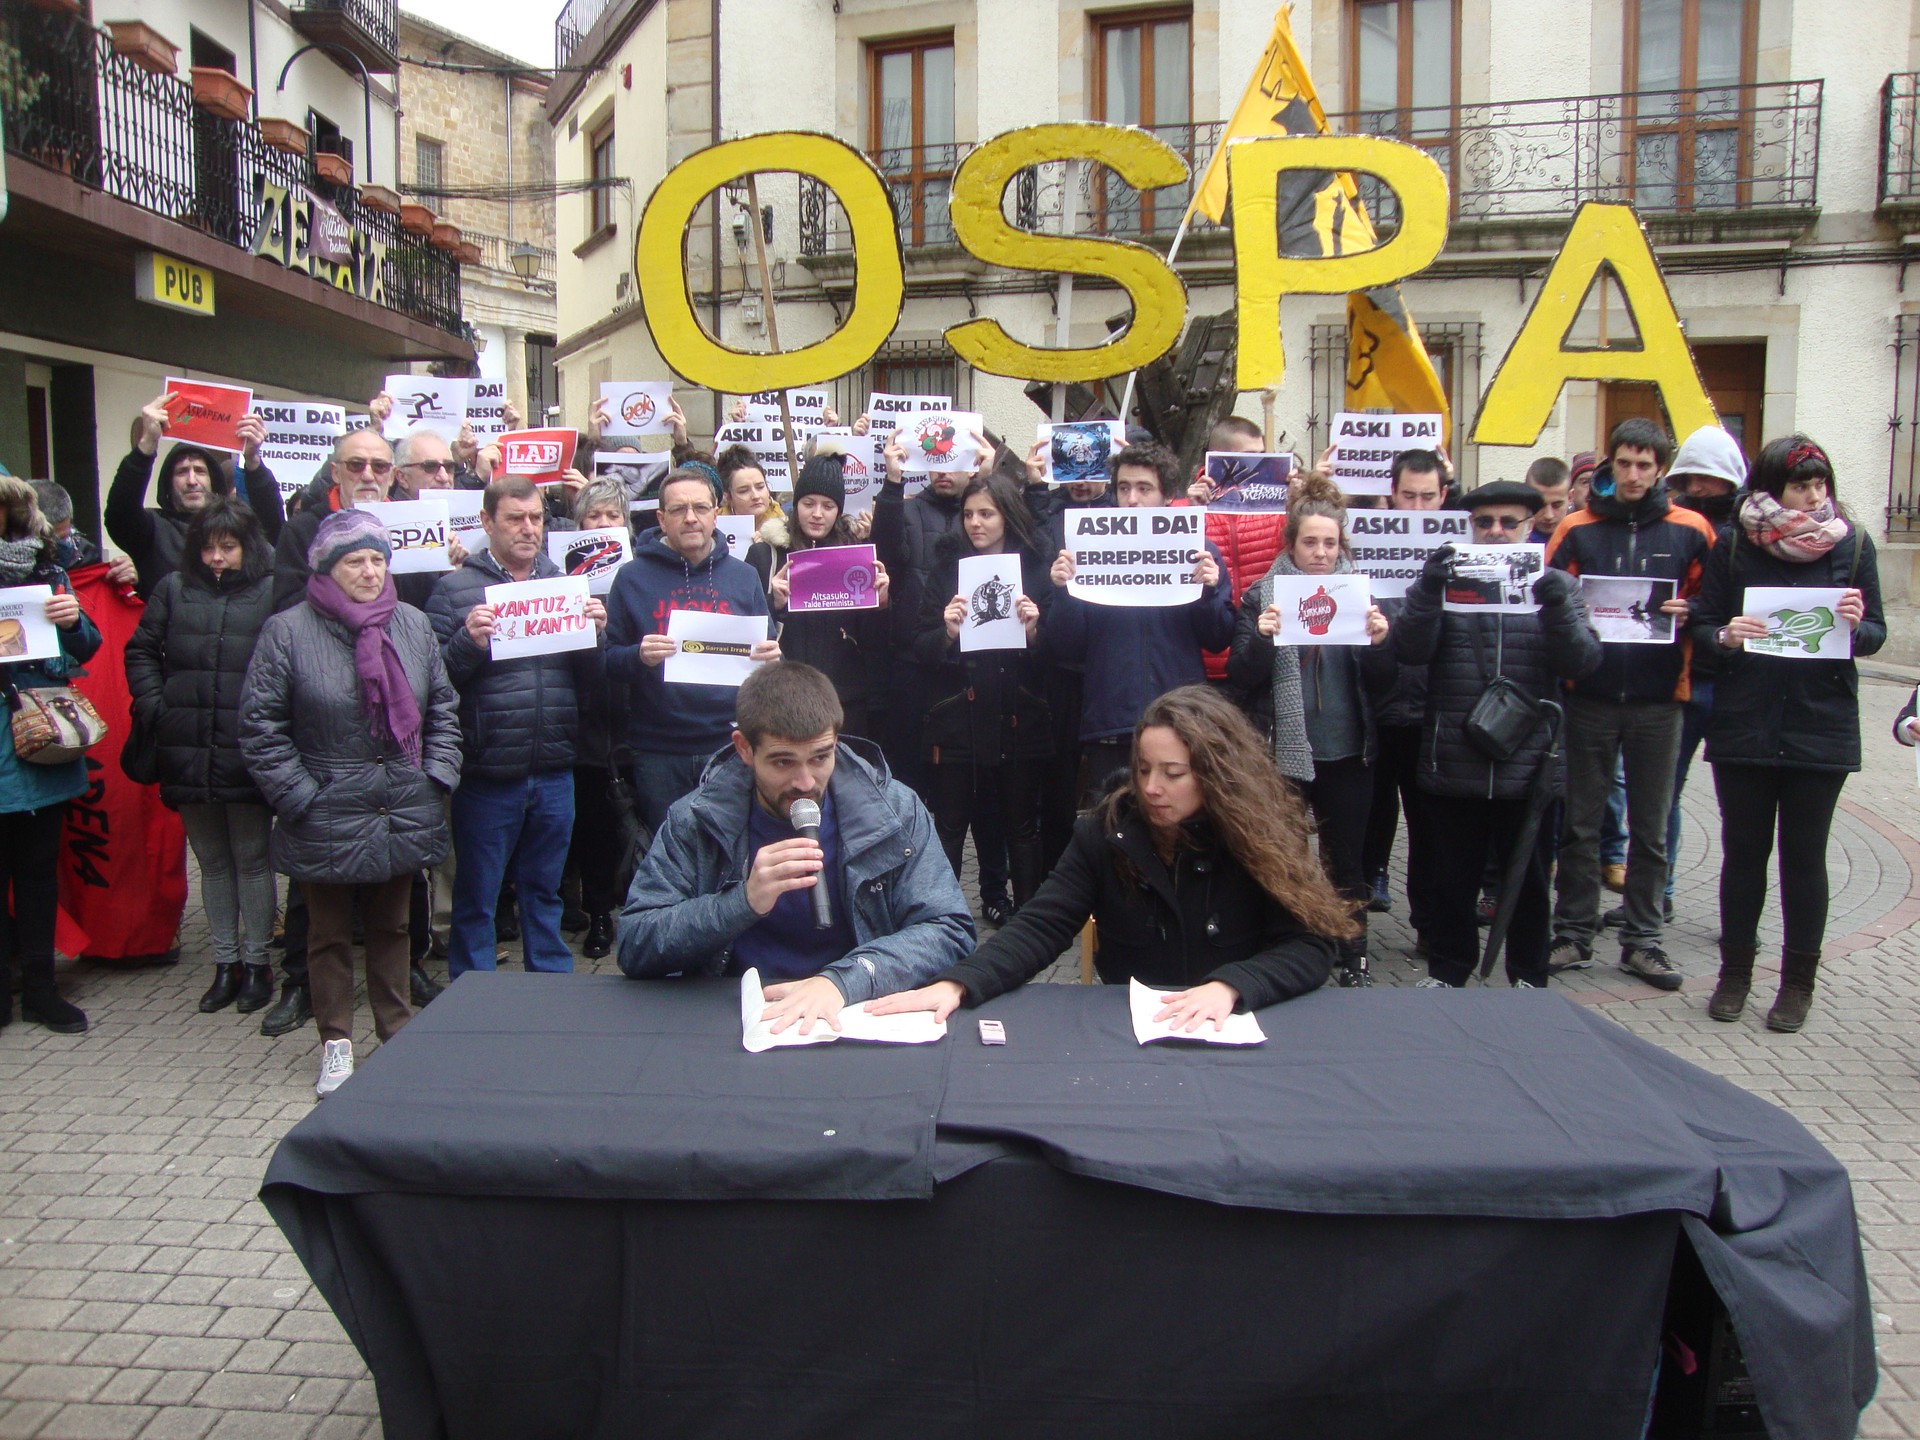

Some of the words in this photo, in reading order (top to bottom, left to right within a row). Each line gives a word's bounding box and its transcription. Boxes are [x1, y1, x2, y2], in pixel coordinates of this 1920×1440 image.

[165, 265, 203, 305] PUB
[635, 122, 1722, 446] OSPA
[474, 384, 503, 398] DA!
[624, 394, 653, 420] aek
[750, 392, 780, 406] ASK
[795, 396, 823, 407] DA!
[874, 399, 911, 411] ASKI
[306, 410, 341, 424] DA!
[721, 429, 762, 441] ASKI
[1340, 421, 1390, 437] ASKI
[1402, 422, 1436, 437] DA!
[510, 445, 558, 463] LAB
[1077, 516, 1137, 535] ASKI
[1152, 515, 1198, 534] DA!
[1352, 517, 1409, 534] ASKI
[1423, 518, 1467, 534] DA!
[1076, 550, 1200, 565] ERREPRESIO
[1075, 574, 1172, 585] GEHIAGORIK
[804, 600, 822, 608] Talde
[822, 599, 854, 607] Feminista
[811, 591, 849, 601] Altsasuko
[493, 595, 570, 619] KANTUZ,
[524, 614, 588, 636] KANTU
